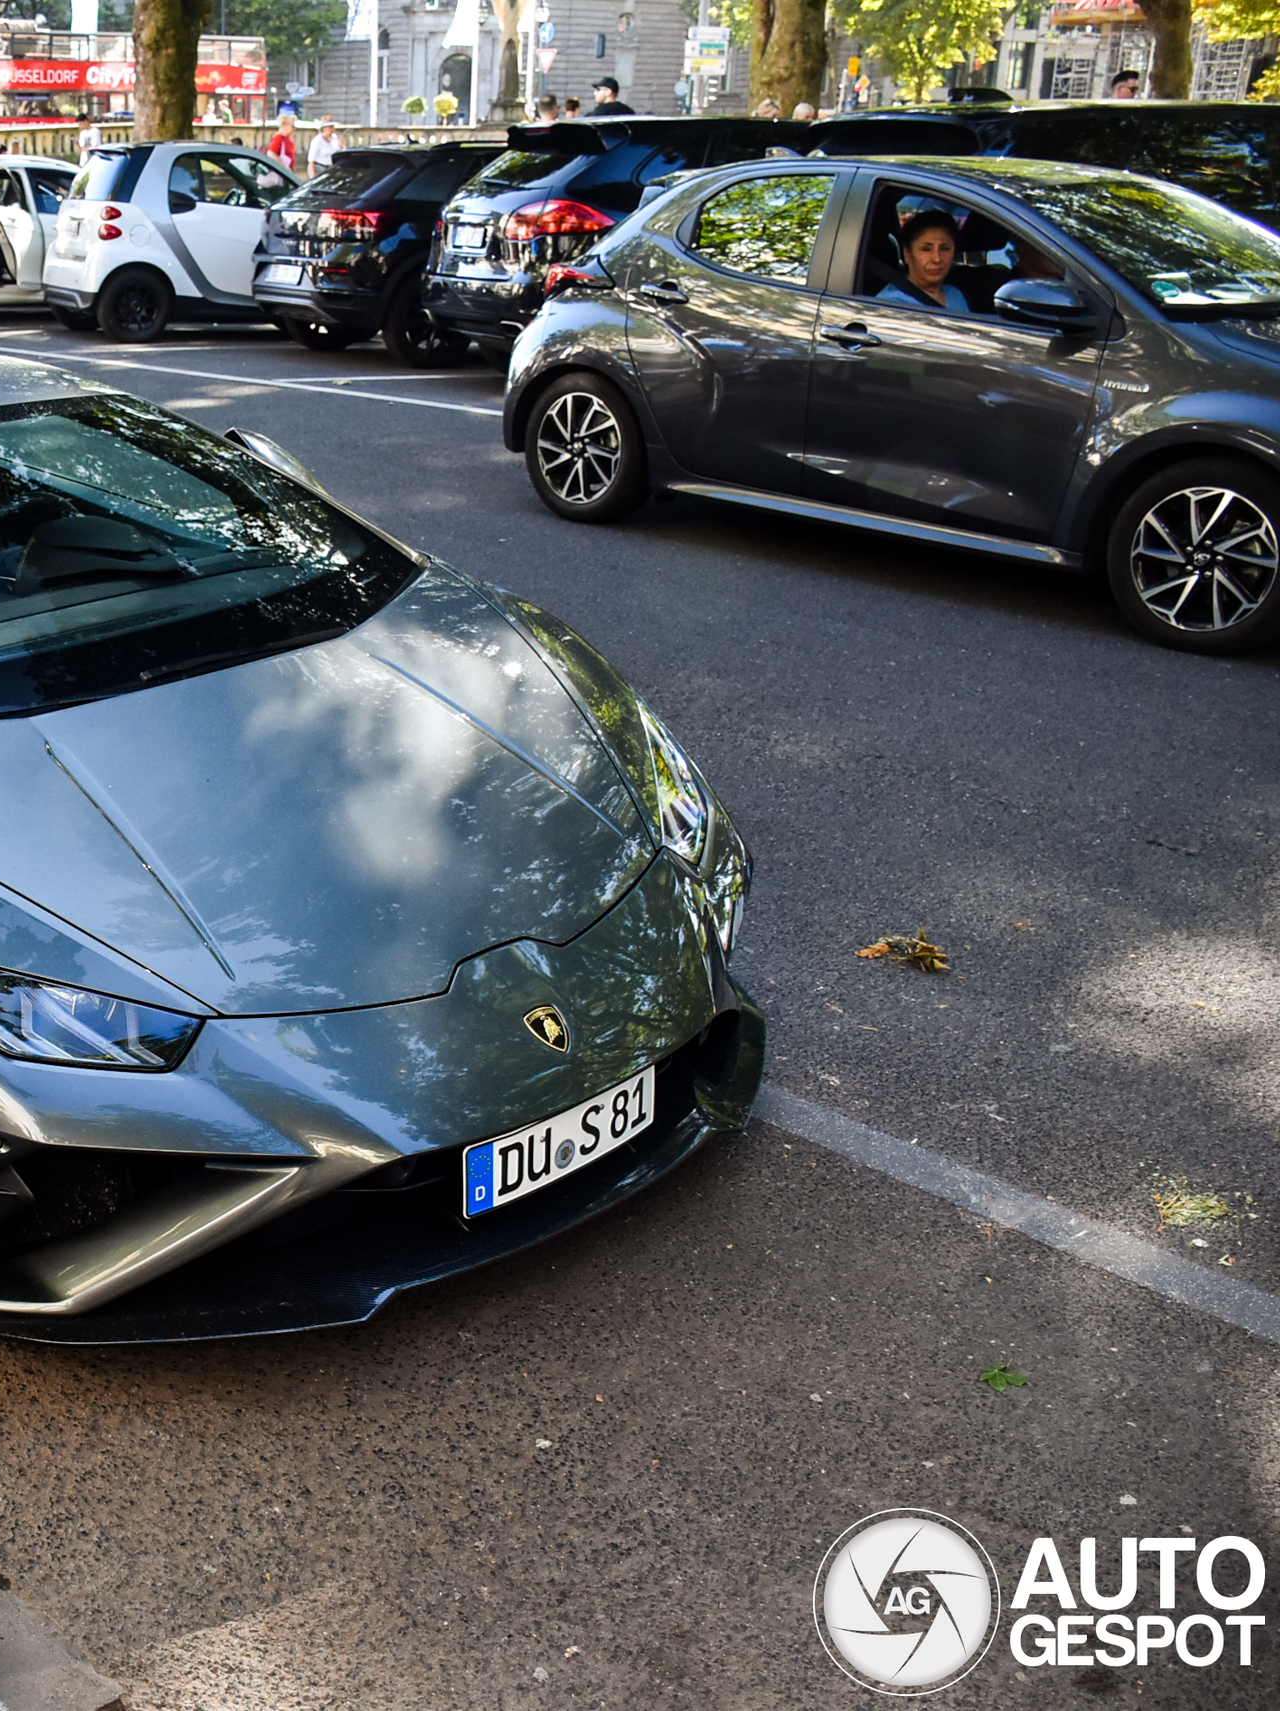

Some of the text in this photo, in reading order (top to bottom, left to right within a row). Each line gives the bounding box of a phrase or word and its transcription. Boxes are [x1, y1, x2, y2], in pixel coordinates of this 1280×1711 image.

[497, 1076, 647, 1197] DU S 81
[474, 1185, 486, 1201] D
